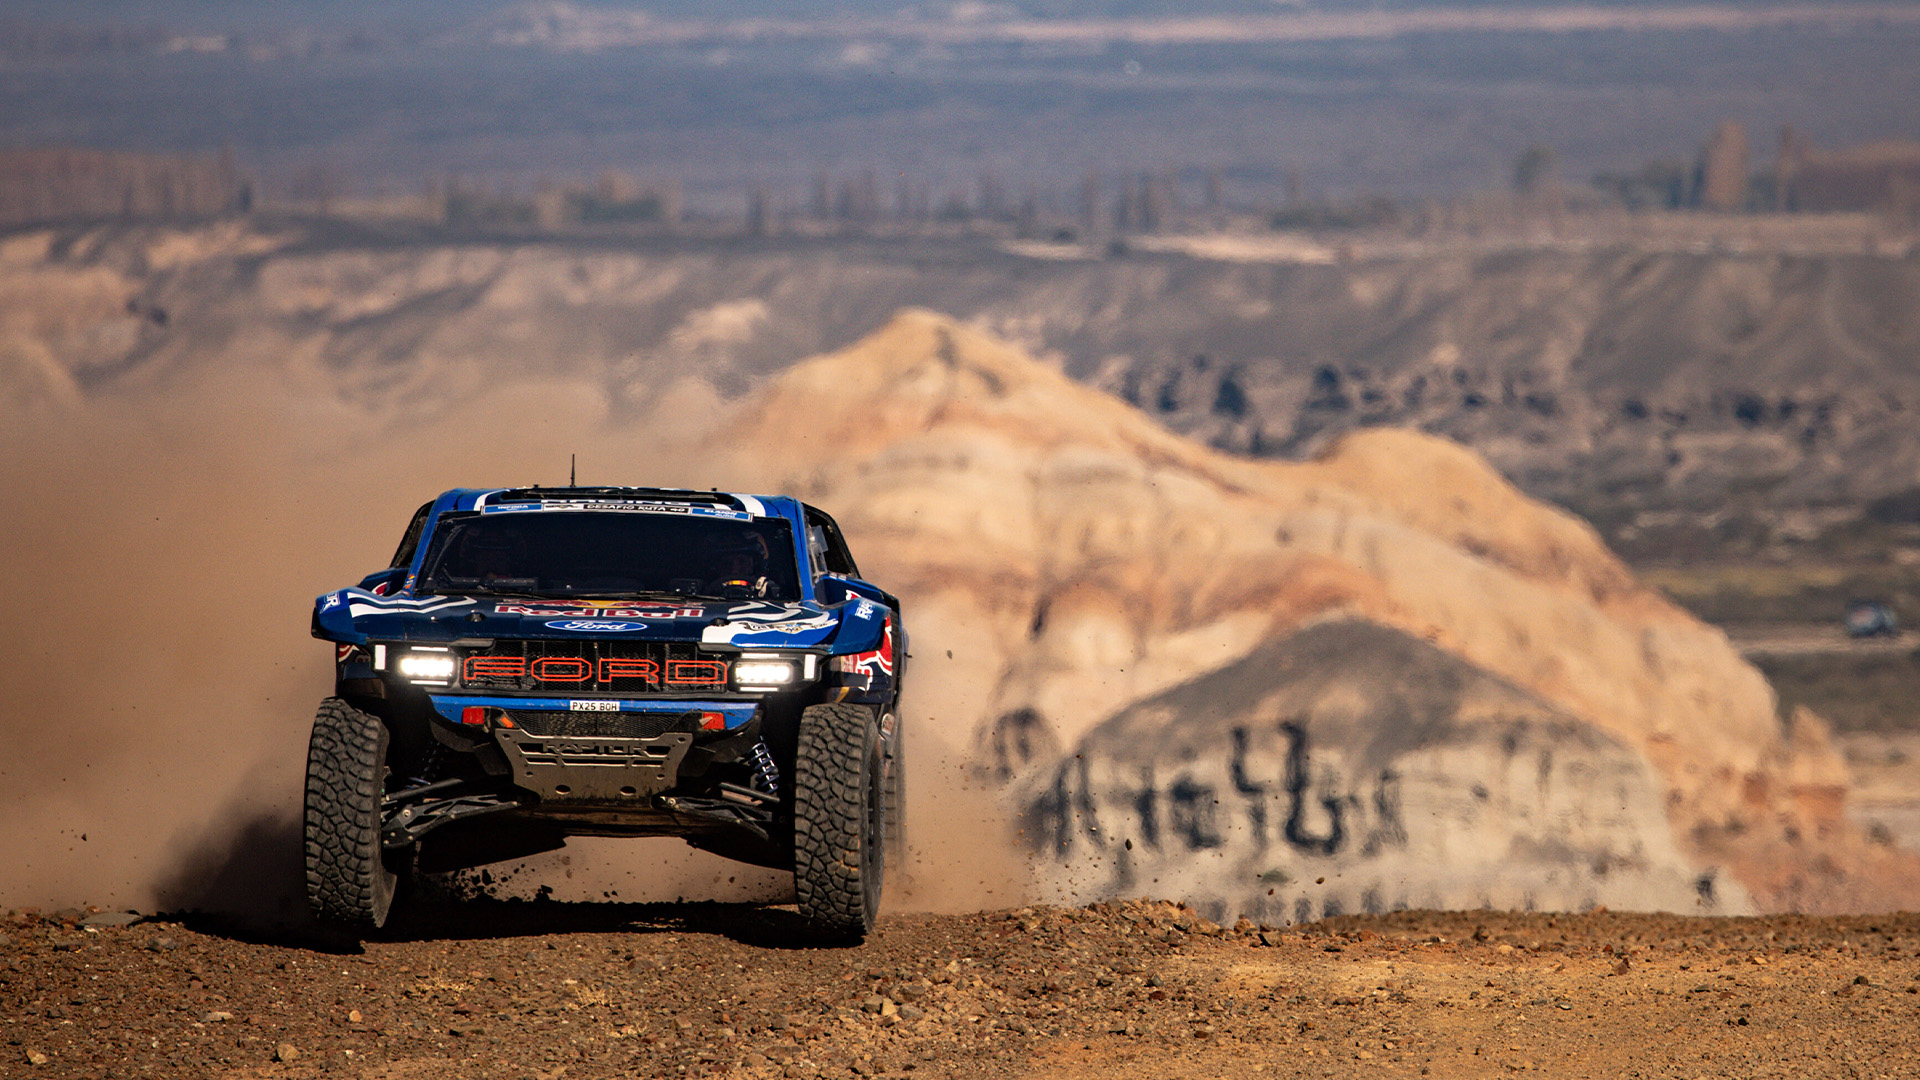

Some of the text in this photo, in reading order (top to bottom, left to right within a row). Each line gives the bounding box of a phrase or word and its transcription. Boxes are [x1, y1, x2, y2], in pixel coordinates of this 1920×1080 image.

[494, 605, 704, 620] Red Bull
[564, 620, 627, 631] Ford
[464, 656, 728, 684] FORD
[572, 701, 617, 711] PX25 BOH
[543, 742, 650, 756] RAPTOR
